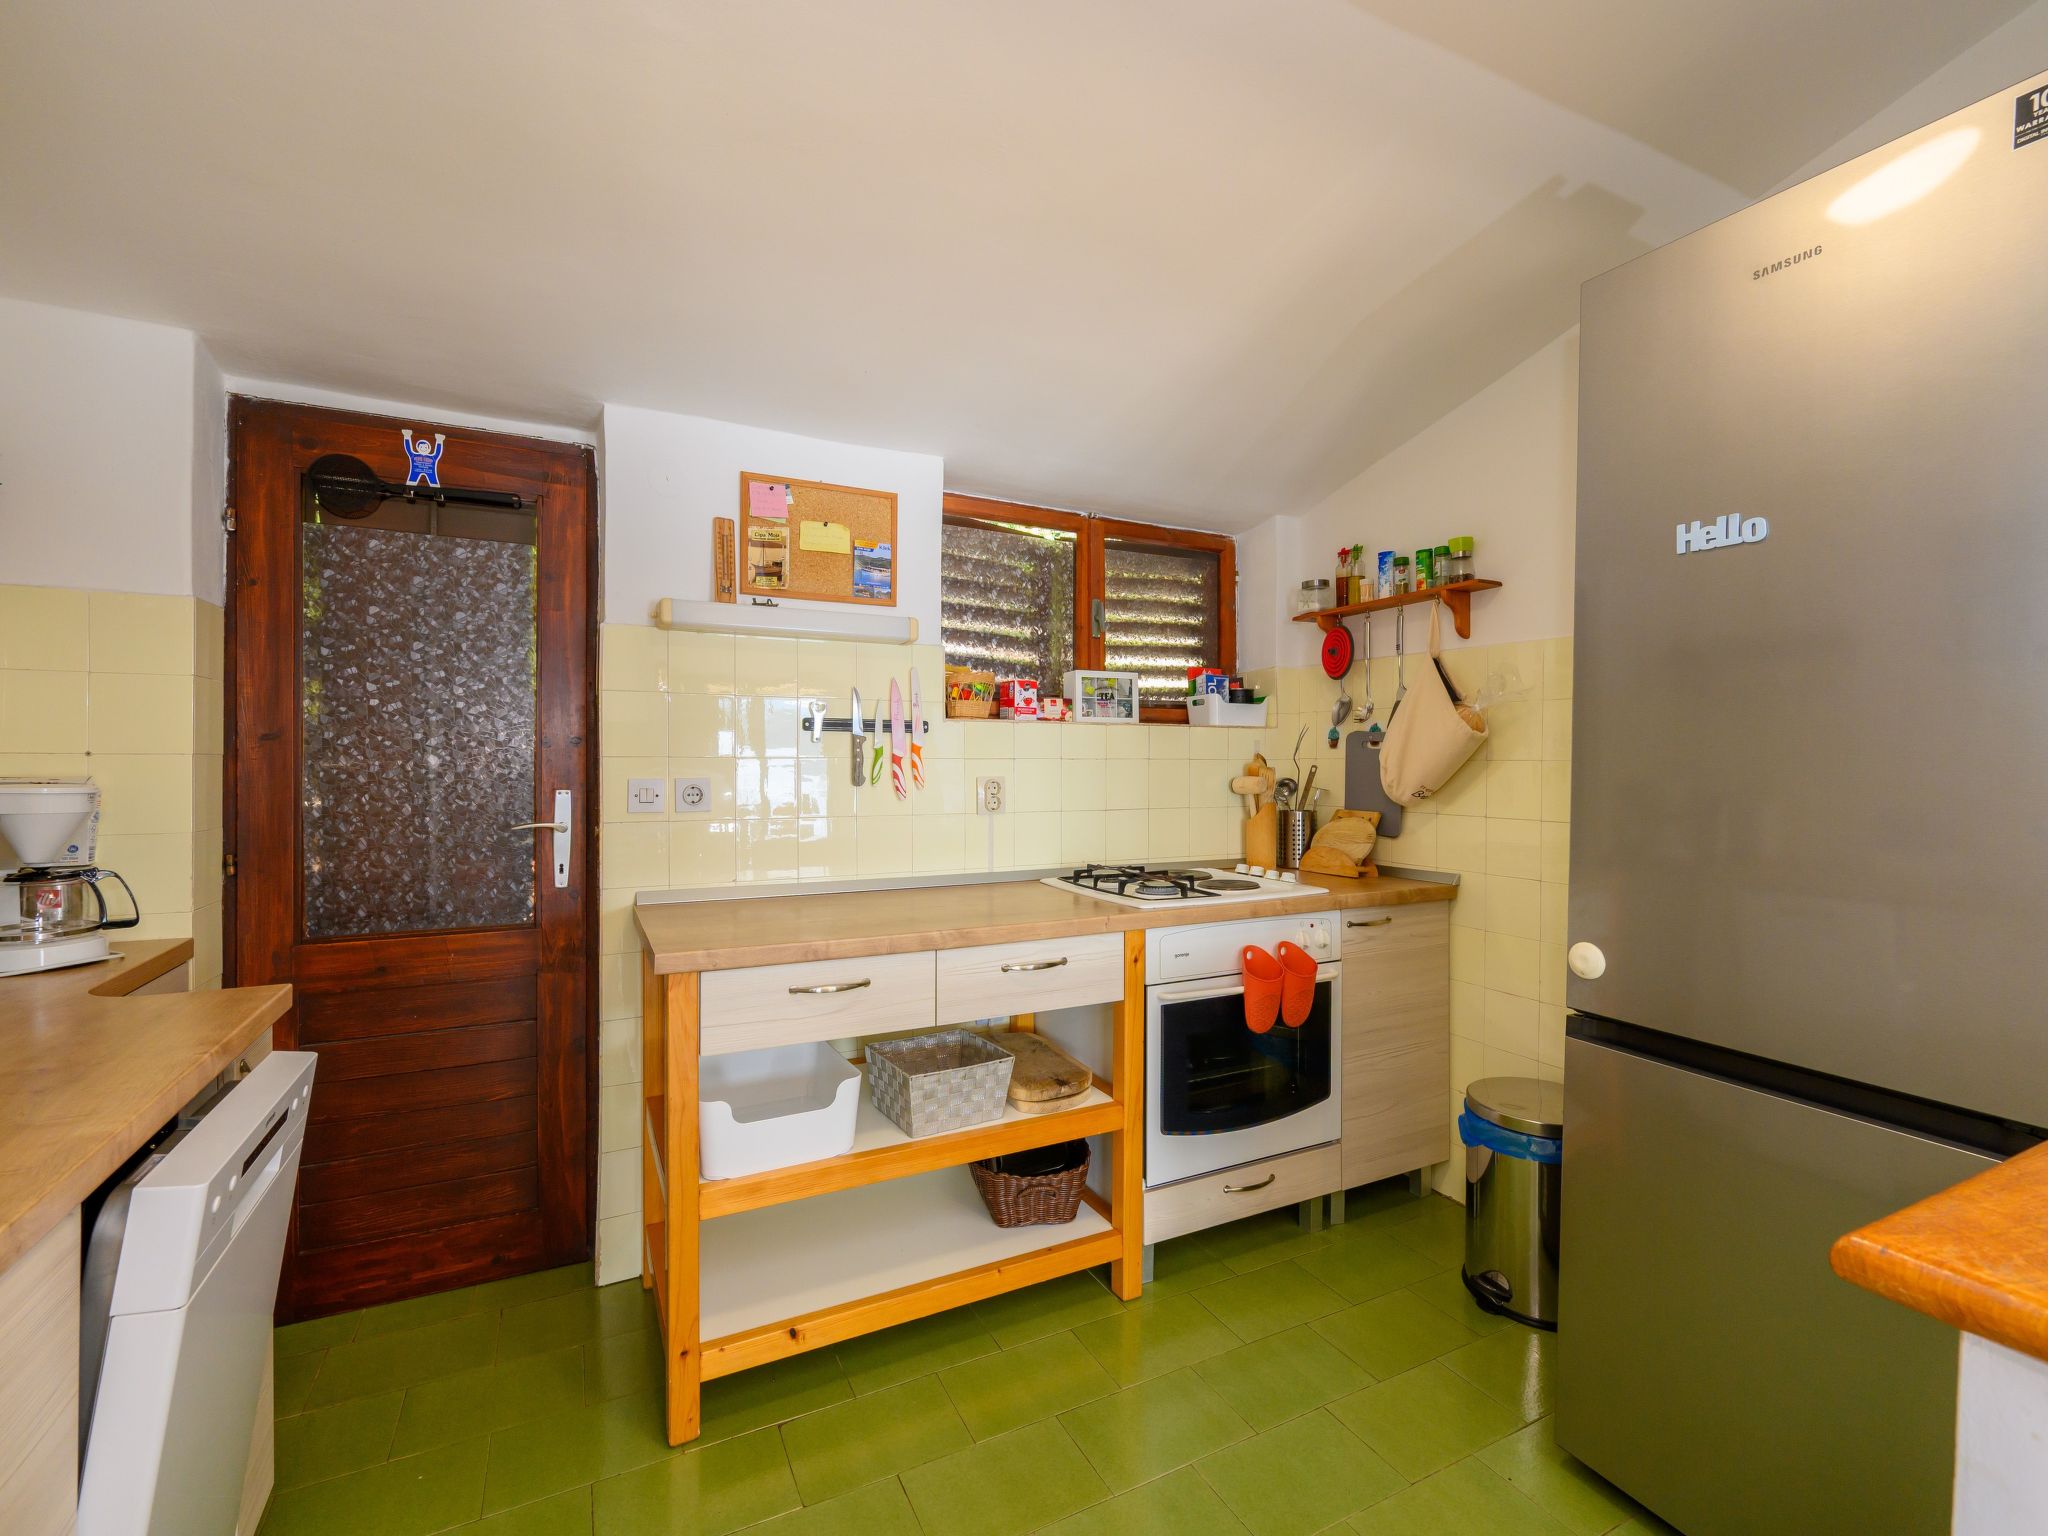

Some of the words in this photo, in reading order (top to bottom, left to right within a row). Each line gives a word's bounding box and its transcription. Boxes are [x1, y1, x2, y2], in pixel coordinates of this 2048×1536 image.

[1752, 245, 1823, 281] SAMSUNG
[1676, 513, 1768, 555] Hello
[1098, 692, 1115, 701] TEA
